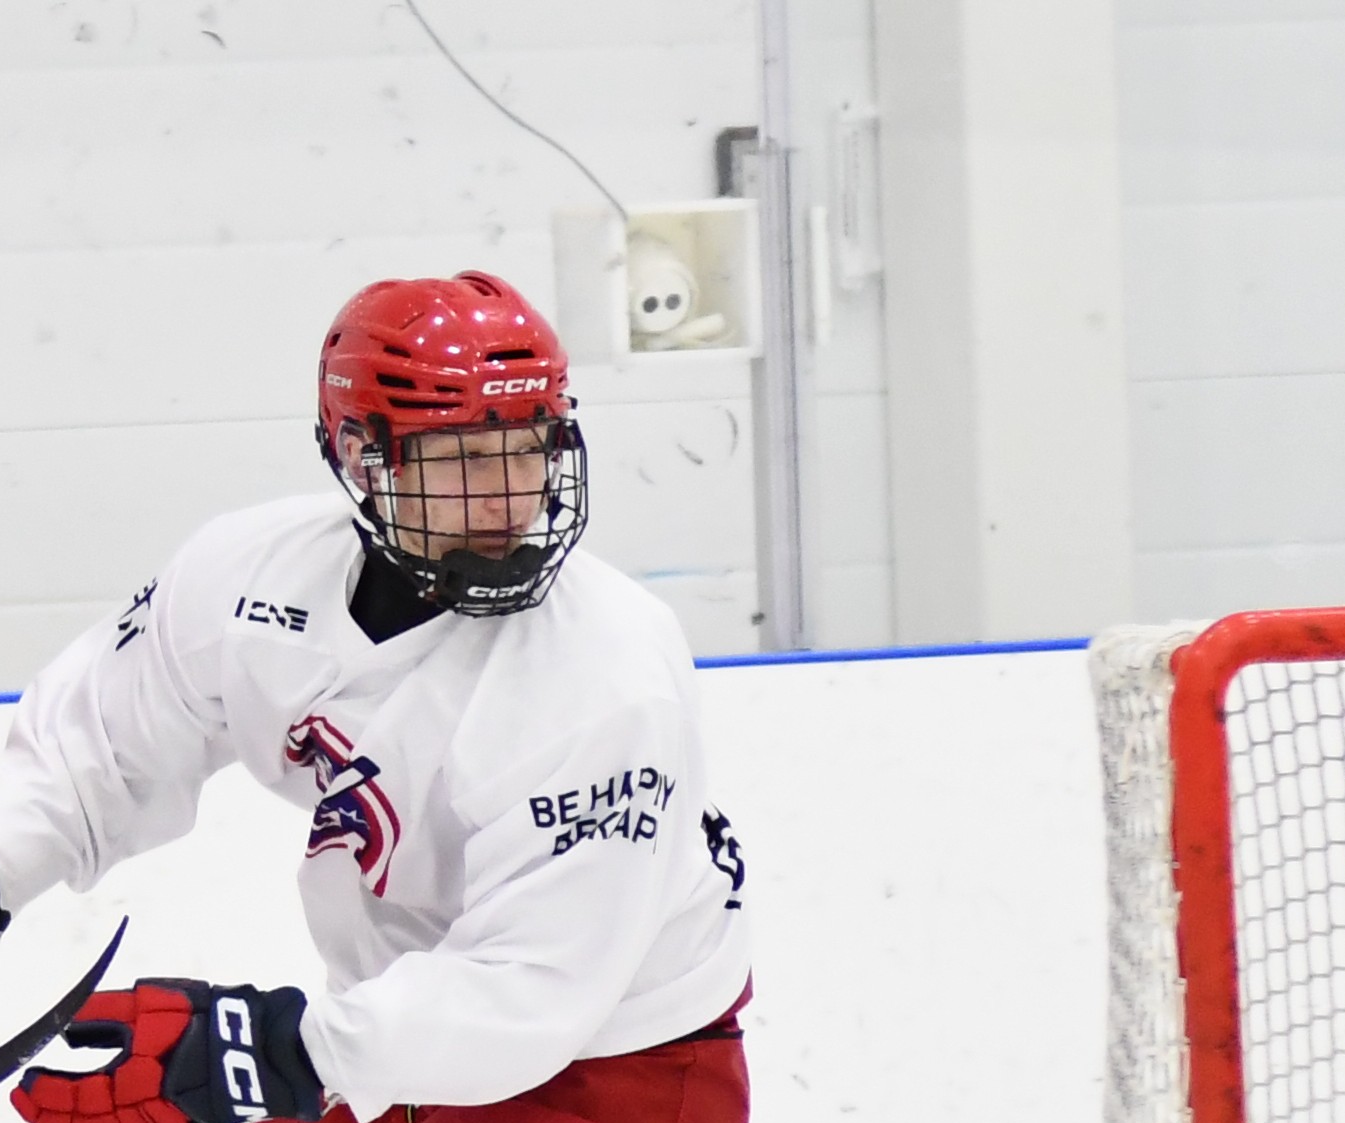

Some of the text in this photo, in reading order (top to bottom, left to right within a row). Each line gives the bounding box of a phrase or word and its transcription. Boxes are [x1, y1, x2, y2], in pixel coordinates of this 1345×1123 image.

[327, 373, 353, 389] CCM
[482, 376, 548, 396] CCM
[529, 789, 581, 828] BE
